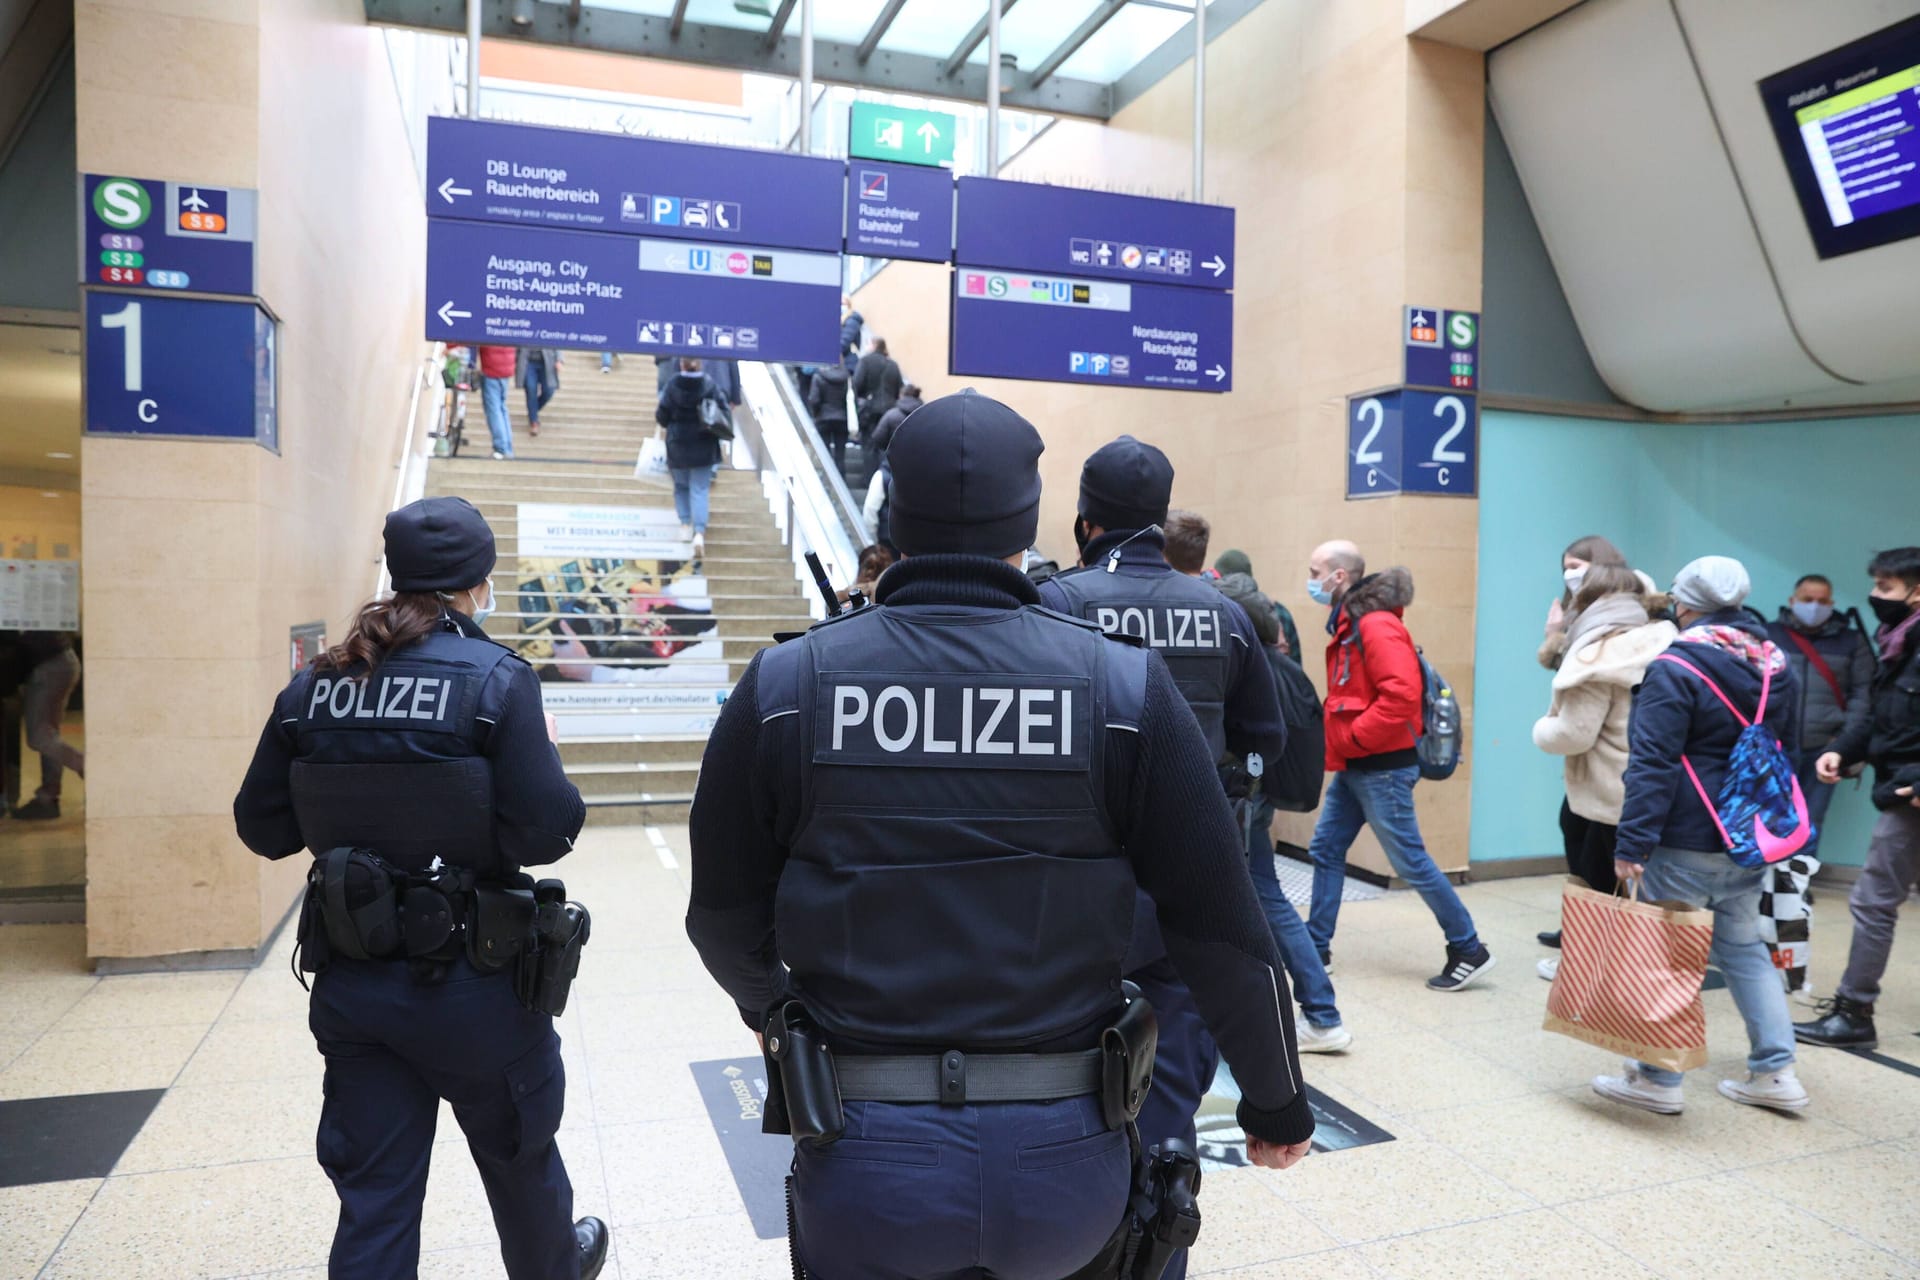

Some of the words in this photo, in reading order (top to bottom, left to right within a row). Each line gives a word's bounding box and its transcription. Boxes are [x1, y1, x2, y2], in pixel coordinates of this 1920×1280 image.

[486, 160, 510, 177] DB
[512, 162, 567, 184] Lounge
[486, 179, 600, 204] Raucherbereich
[103, 182, 142, 225] S
[486, 206, 521, 218] smoking
[522, 209, 540, 218] area
[654, 198, 672, 223] P
[858, 203, 920, 221] Rauchfreier
[858, 218, 903, 234] Bahnhof
[487, 255, 556, 277] Ausgang,
[559, 260, 589, 280] City
[692, 250, 707, 270] U
[728, 257, 748, 270] BUS
[1071, 252, 1089, 263] WC
[486, 274, 623, 299] Ernst-August-Platz
[990, 278, 1006, 297] S
[1054, 284, 1068, 300] U
[486, 293, 585, 315] Reisezentrum
[485, 317, 502, 326] exit
[507, 318, 531, 328] sortie
[1452, 315, 1472, 345] S
[567, 333, 579, 341] de
[1132, 325, 1198, 345] Nordausgang
[101, 302, 142, 391] 1
[1142, 341, 1197, 357] Raschplatz
[1175, 358, 1197, 372] ZOB
[1356, 398, 1383, 464] 2
[1432, 396, 1466, 463] 2
[1099, 607, 1220, 648] POLIZEI
[308, 676, 451, 721] POLIZEI
[832, 685, 1072, 756] POLIZEI
